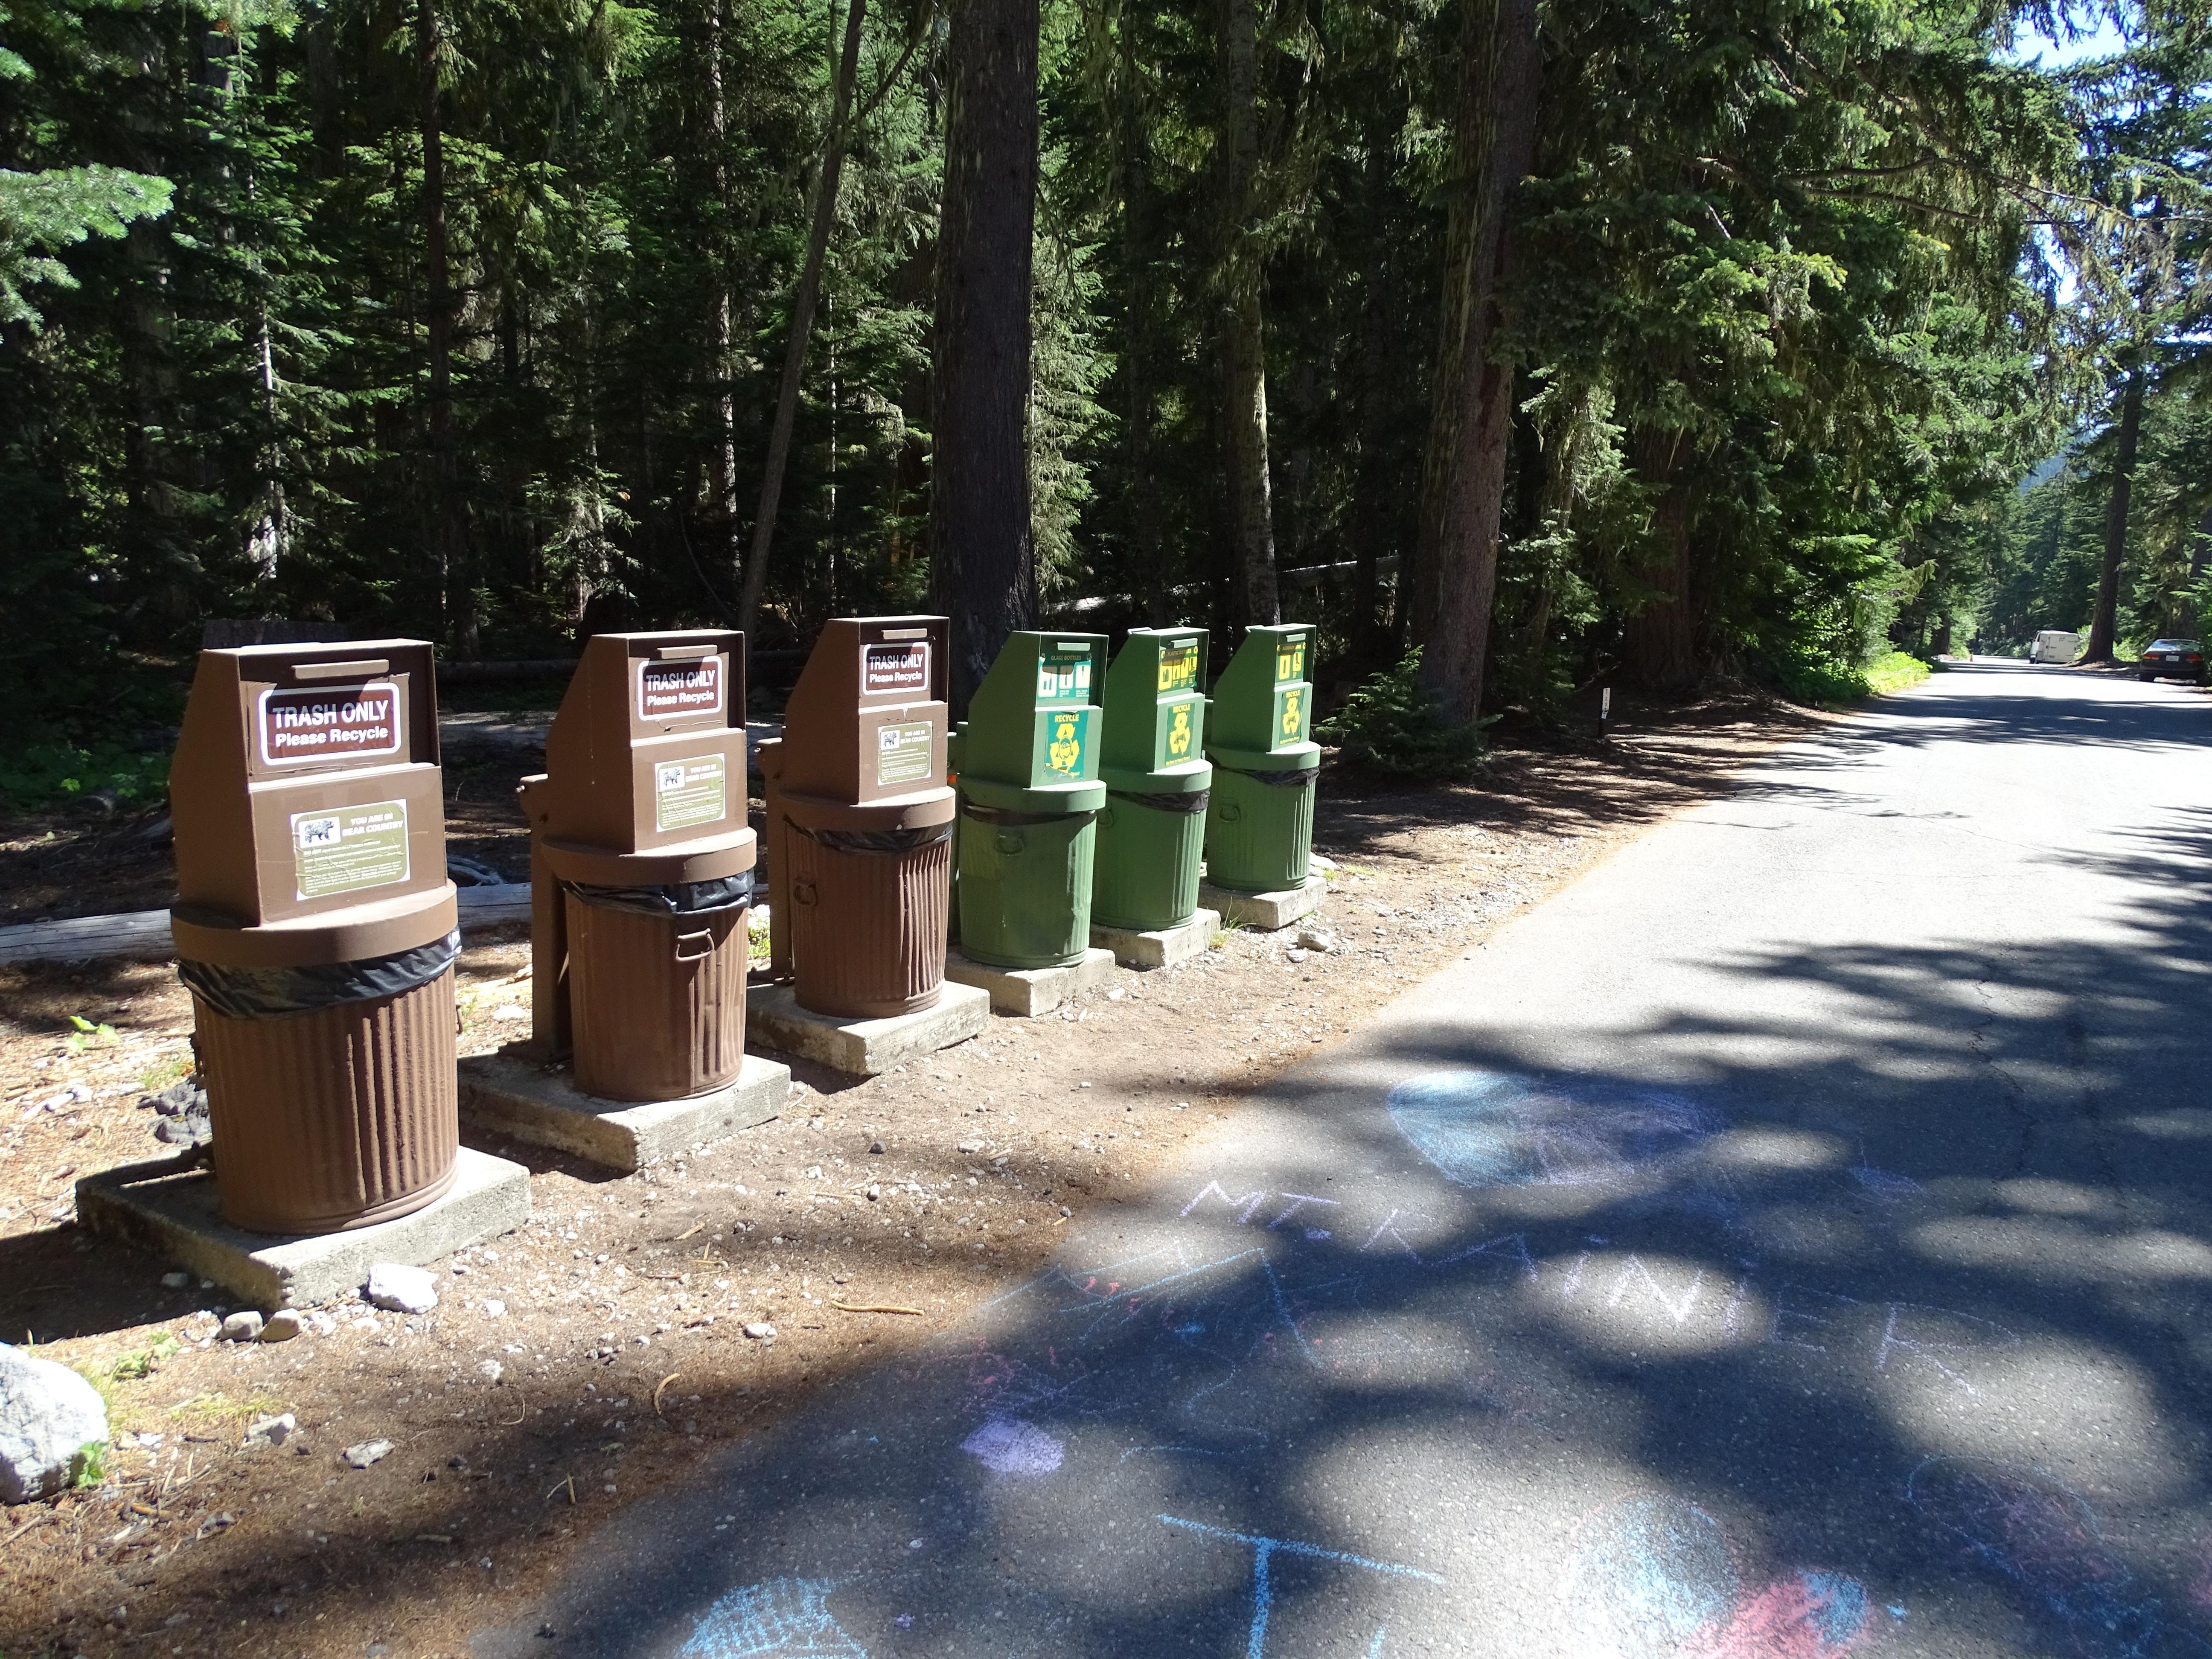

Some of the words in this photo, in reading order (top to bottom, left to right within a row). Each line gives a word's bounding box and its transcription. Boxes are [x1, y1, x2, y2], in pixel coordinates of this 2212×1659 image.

[870, 655, 899, 670] TRASH
[901, 653, 923, 669] ONLY
[646, 672, 684, 691] TRASH
[687, 670, 716, 688] ONLY
[870, 673, 894, 683] Please
[894, 671, 922, 682] Recycle
[647, 695, 678, 706] Please
[679, 690, 715, 704] Recycle
[1286, 689, 1301, 698] RECYCLE
[273, 703, 337, 729] TRASH
[341, 700, 389, 723] ONLY
[1173, 704, 1190, 713] RECYCLE
[1055, 714, 1080, 722] RECYCLE
[276, 732, 326, 747] Please
[330, 725, 388, 743] Recycle
[350, 816, 367, 826] YOU
[369, 814, 383, 823] ARE
[342, 827, 365, 836] BEAR
[366, 821, 404, 832] COUNTRY
